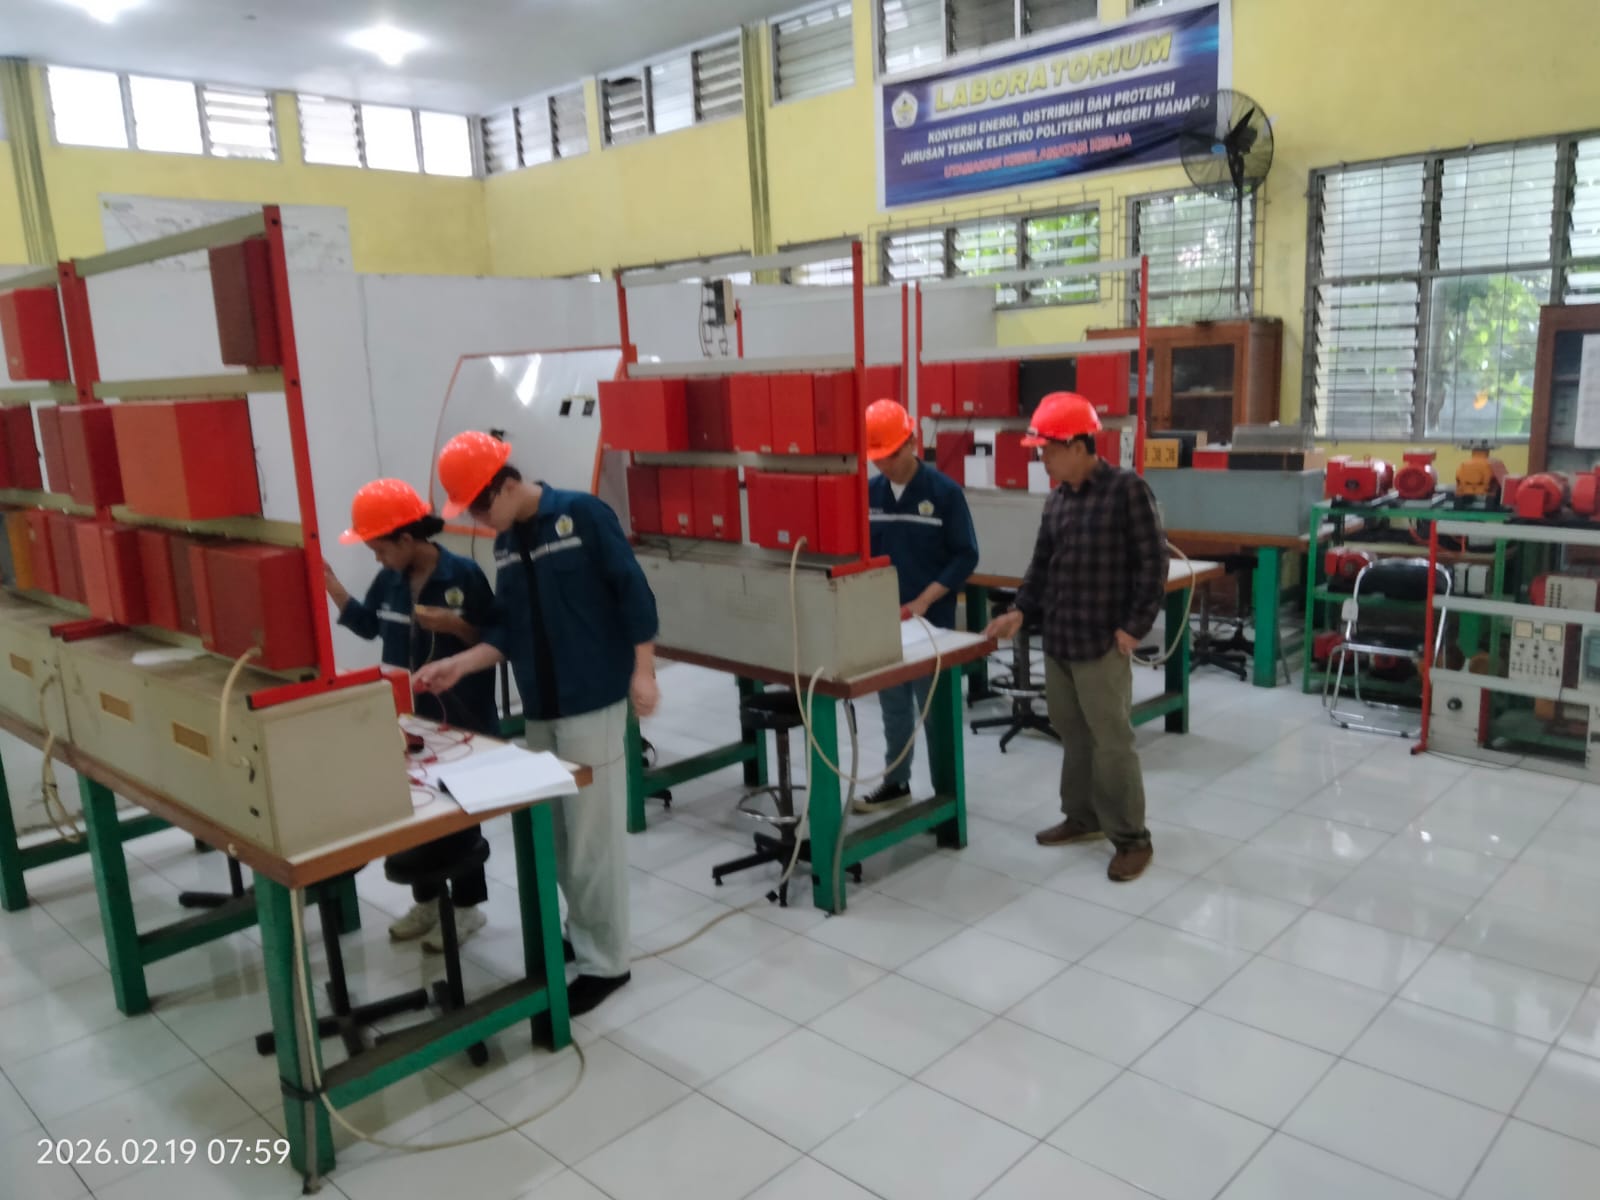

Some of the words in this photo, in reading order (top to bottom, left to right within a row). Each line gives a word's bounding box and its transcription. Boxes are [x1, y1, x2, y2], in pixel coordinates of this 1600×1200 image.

[934, 31, 1172, 112] LABORATORIUM
[901, 145, 945, 166] JURUSAN
[948, 139, 983, 156] TEKNIK
[986, 129, 1033, 149] ELEKTRO
[1036, 113, 1104, 139] POLITEKNIK
[1106, 105, 1151, 127] NEGERI
[928, 121, 976, 144] KONVERSI
[979, 113, 1019, 134] ENERGI,
[1023, 96, 1084, 124] DISTRIBUSI
[1114, 80, 1176, 107] PROTEKSI
